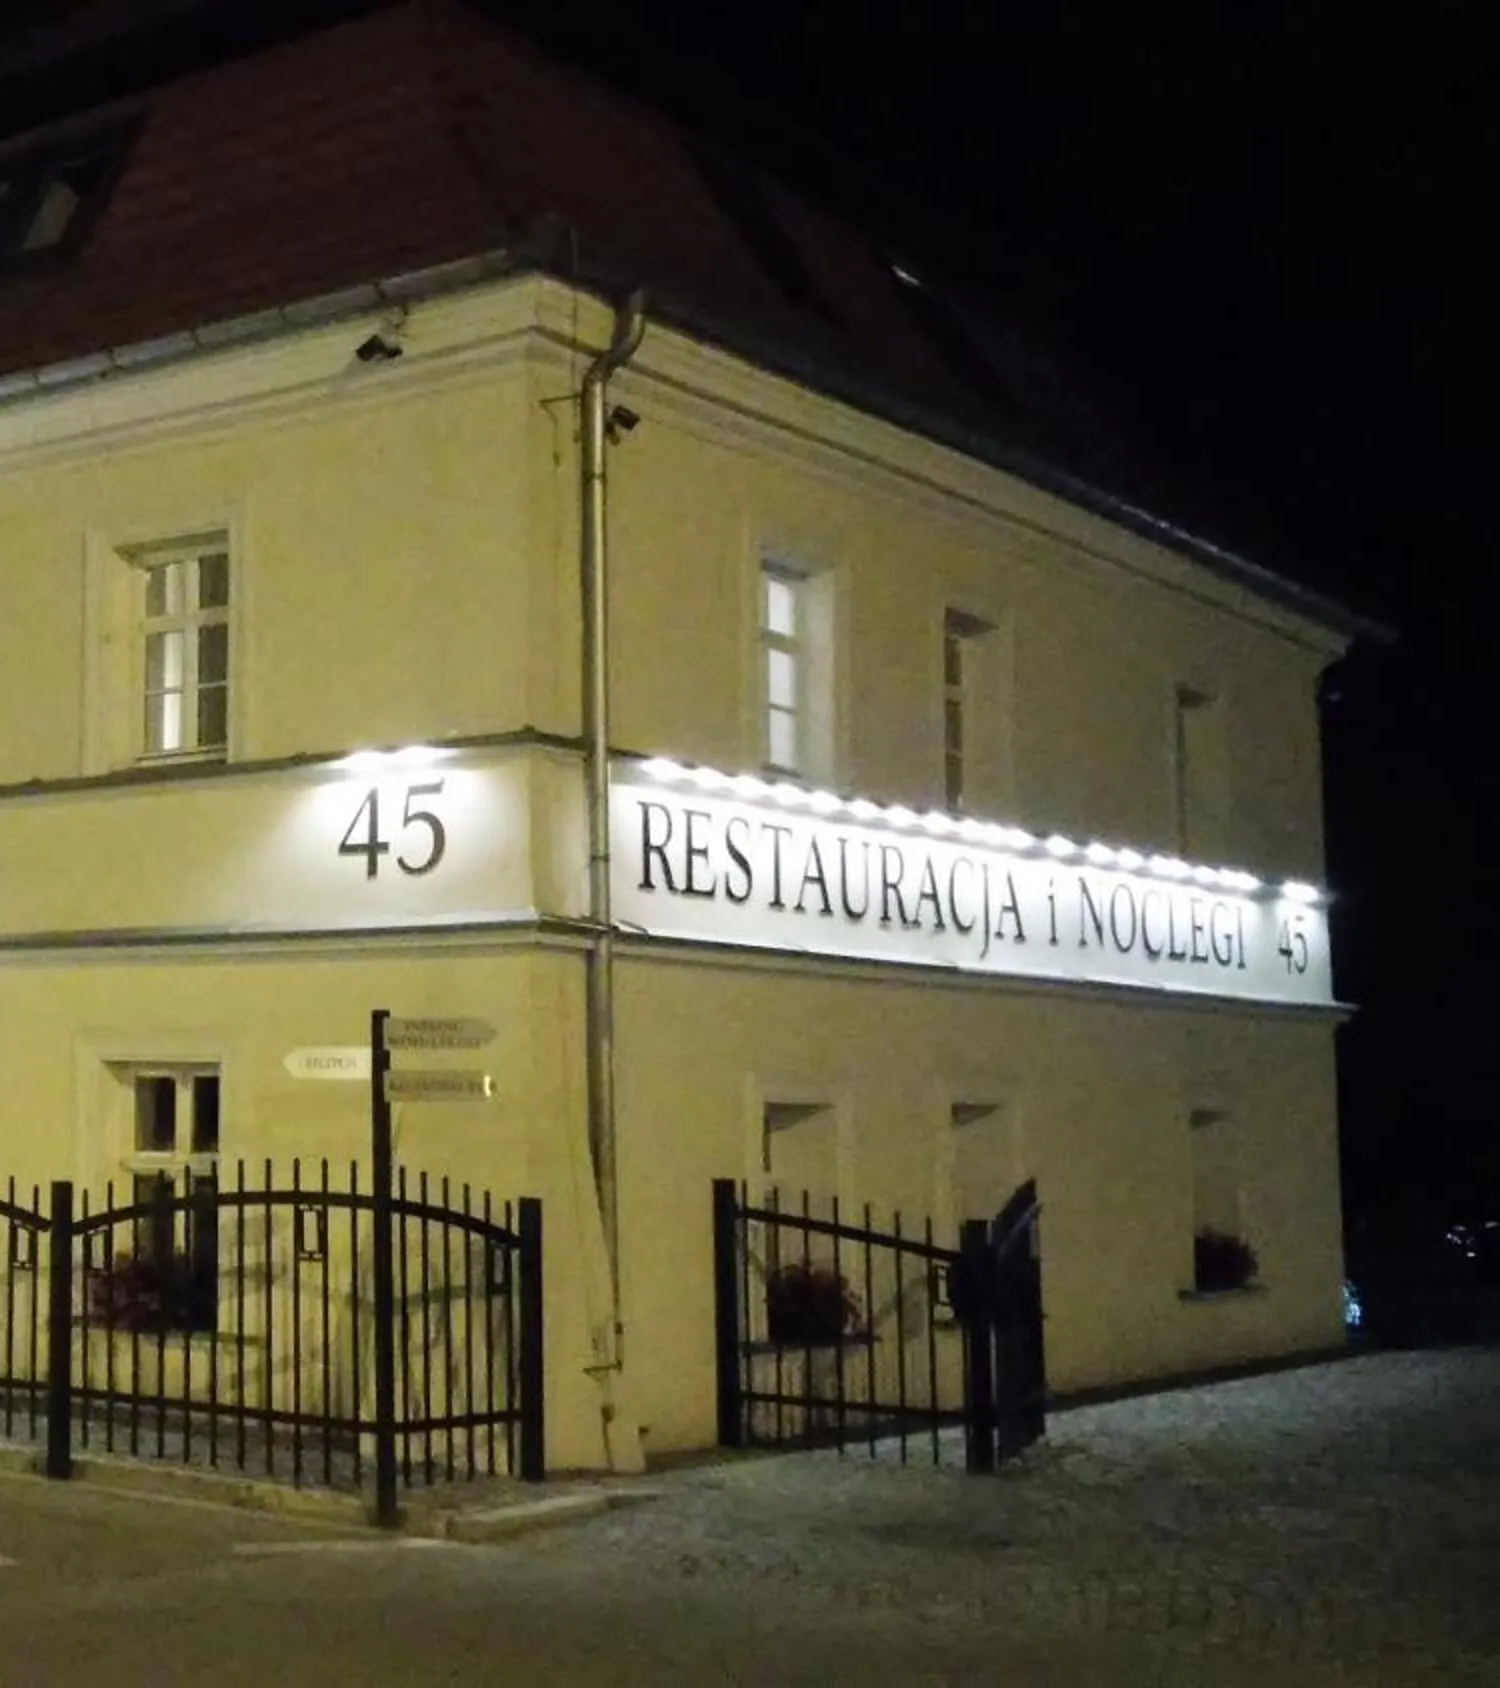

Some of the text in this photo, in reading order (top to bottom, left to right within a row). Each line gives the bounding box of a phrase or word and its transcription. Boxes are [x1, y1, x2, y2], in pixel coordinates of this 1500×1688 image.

[338, 776, 446, 881] 45
[636, 799, 1308, 976] RESTAURACJA i NOCLEGI 45
